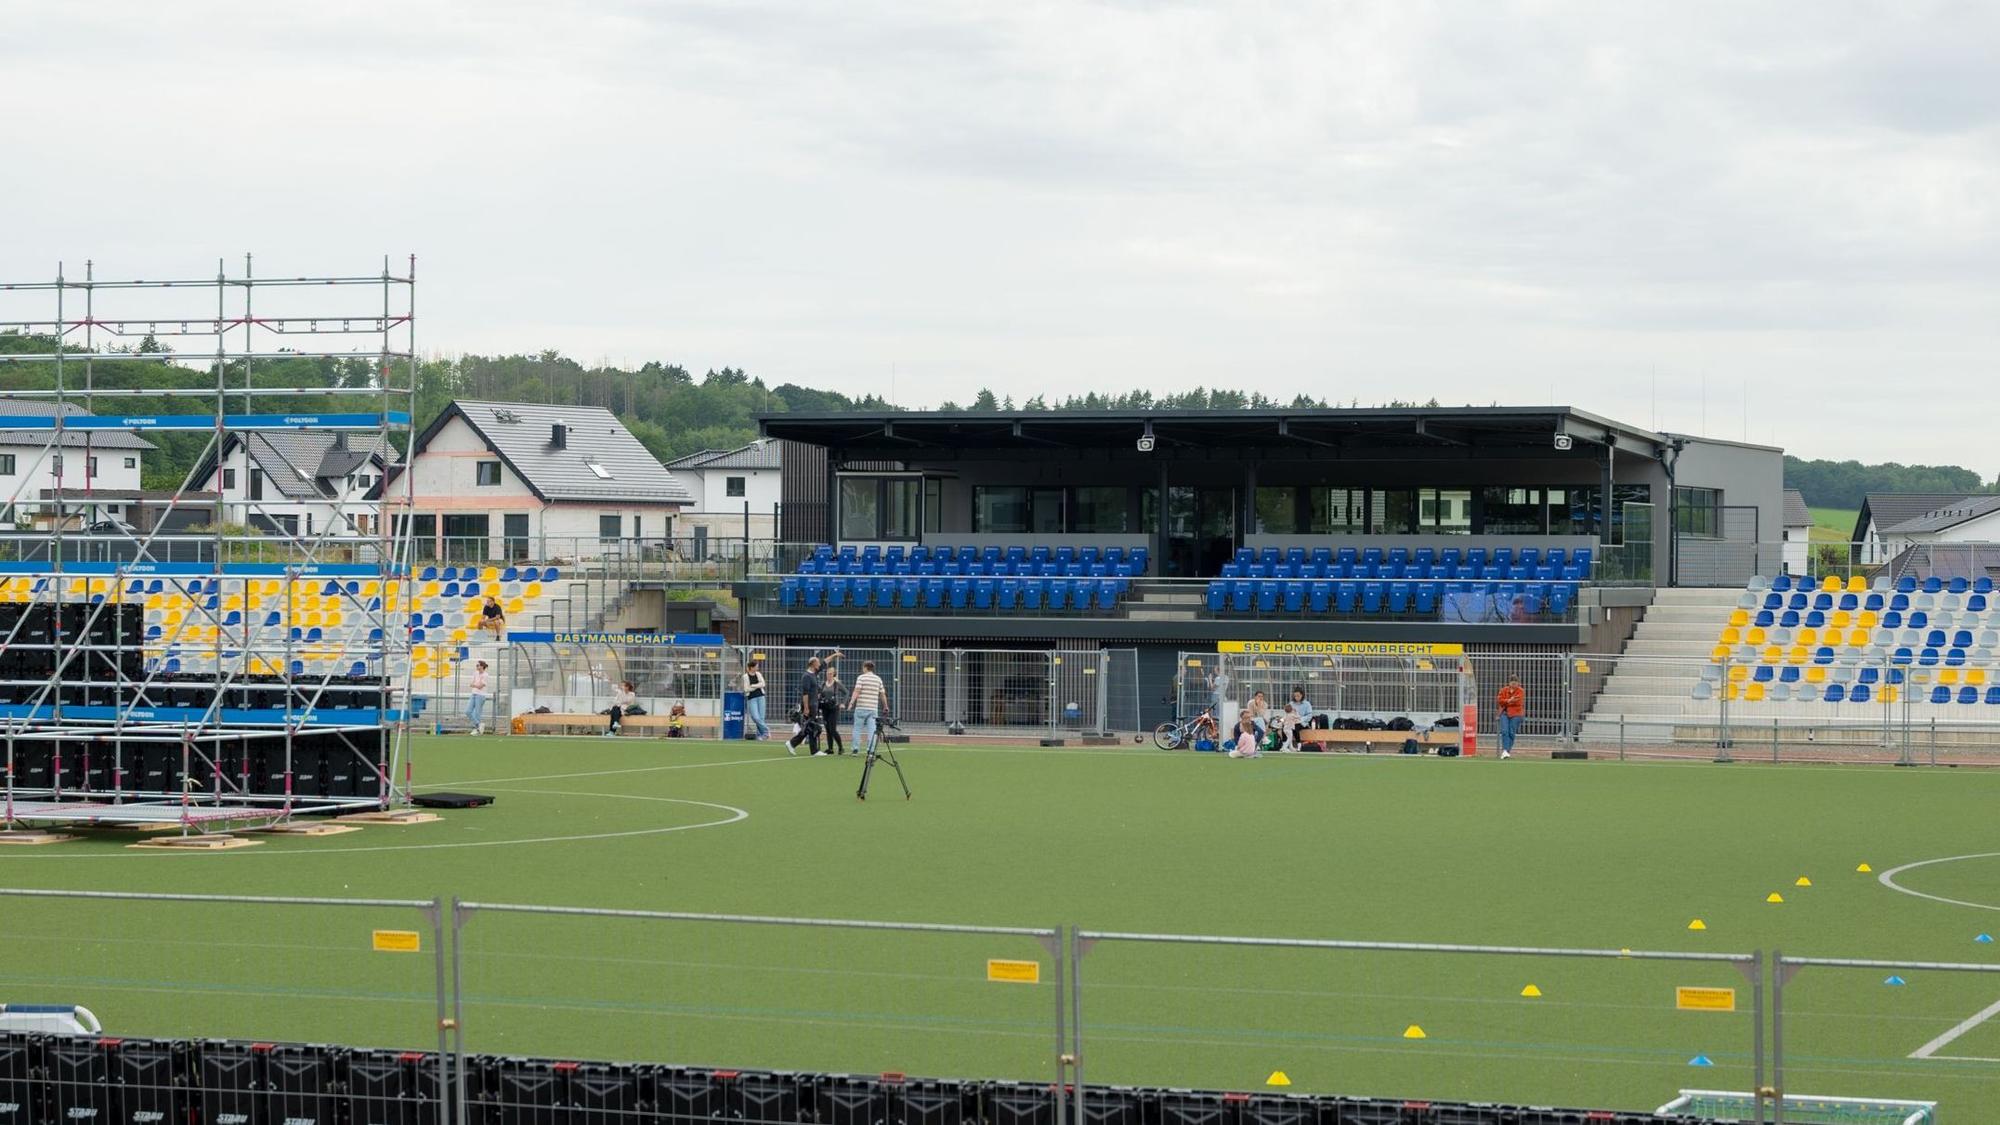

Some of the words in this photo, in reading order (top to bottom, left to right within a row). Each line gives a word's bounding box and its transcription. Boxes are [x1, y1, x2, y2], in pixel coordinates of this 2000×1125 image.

[554, 633, 676, 644] GASTMANNSCHAFT
[1244, 643, 1270, 652] SSV
[1275, 643, 1343, 653] HOMBURG
